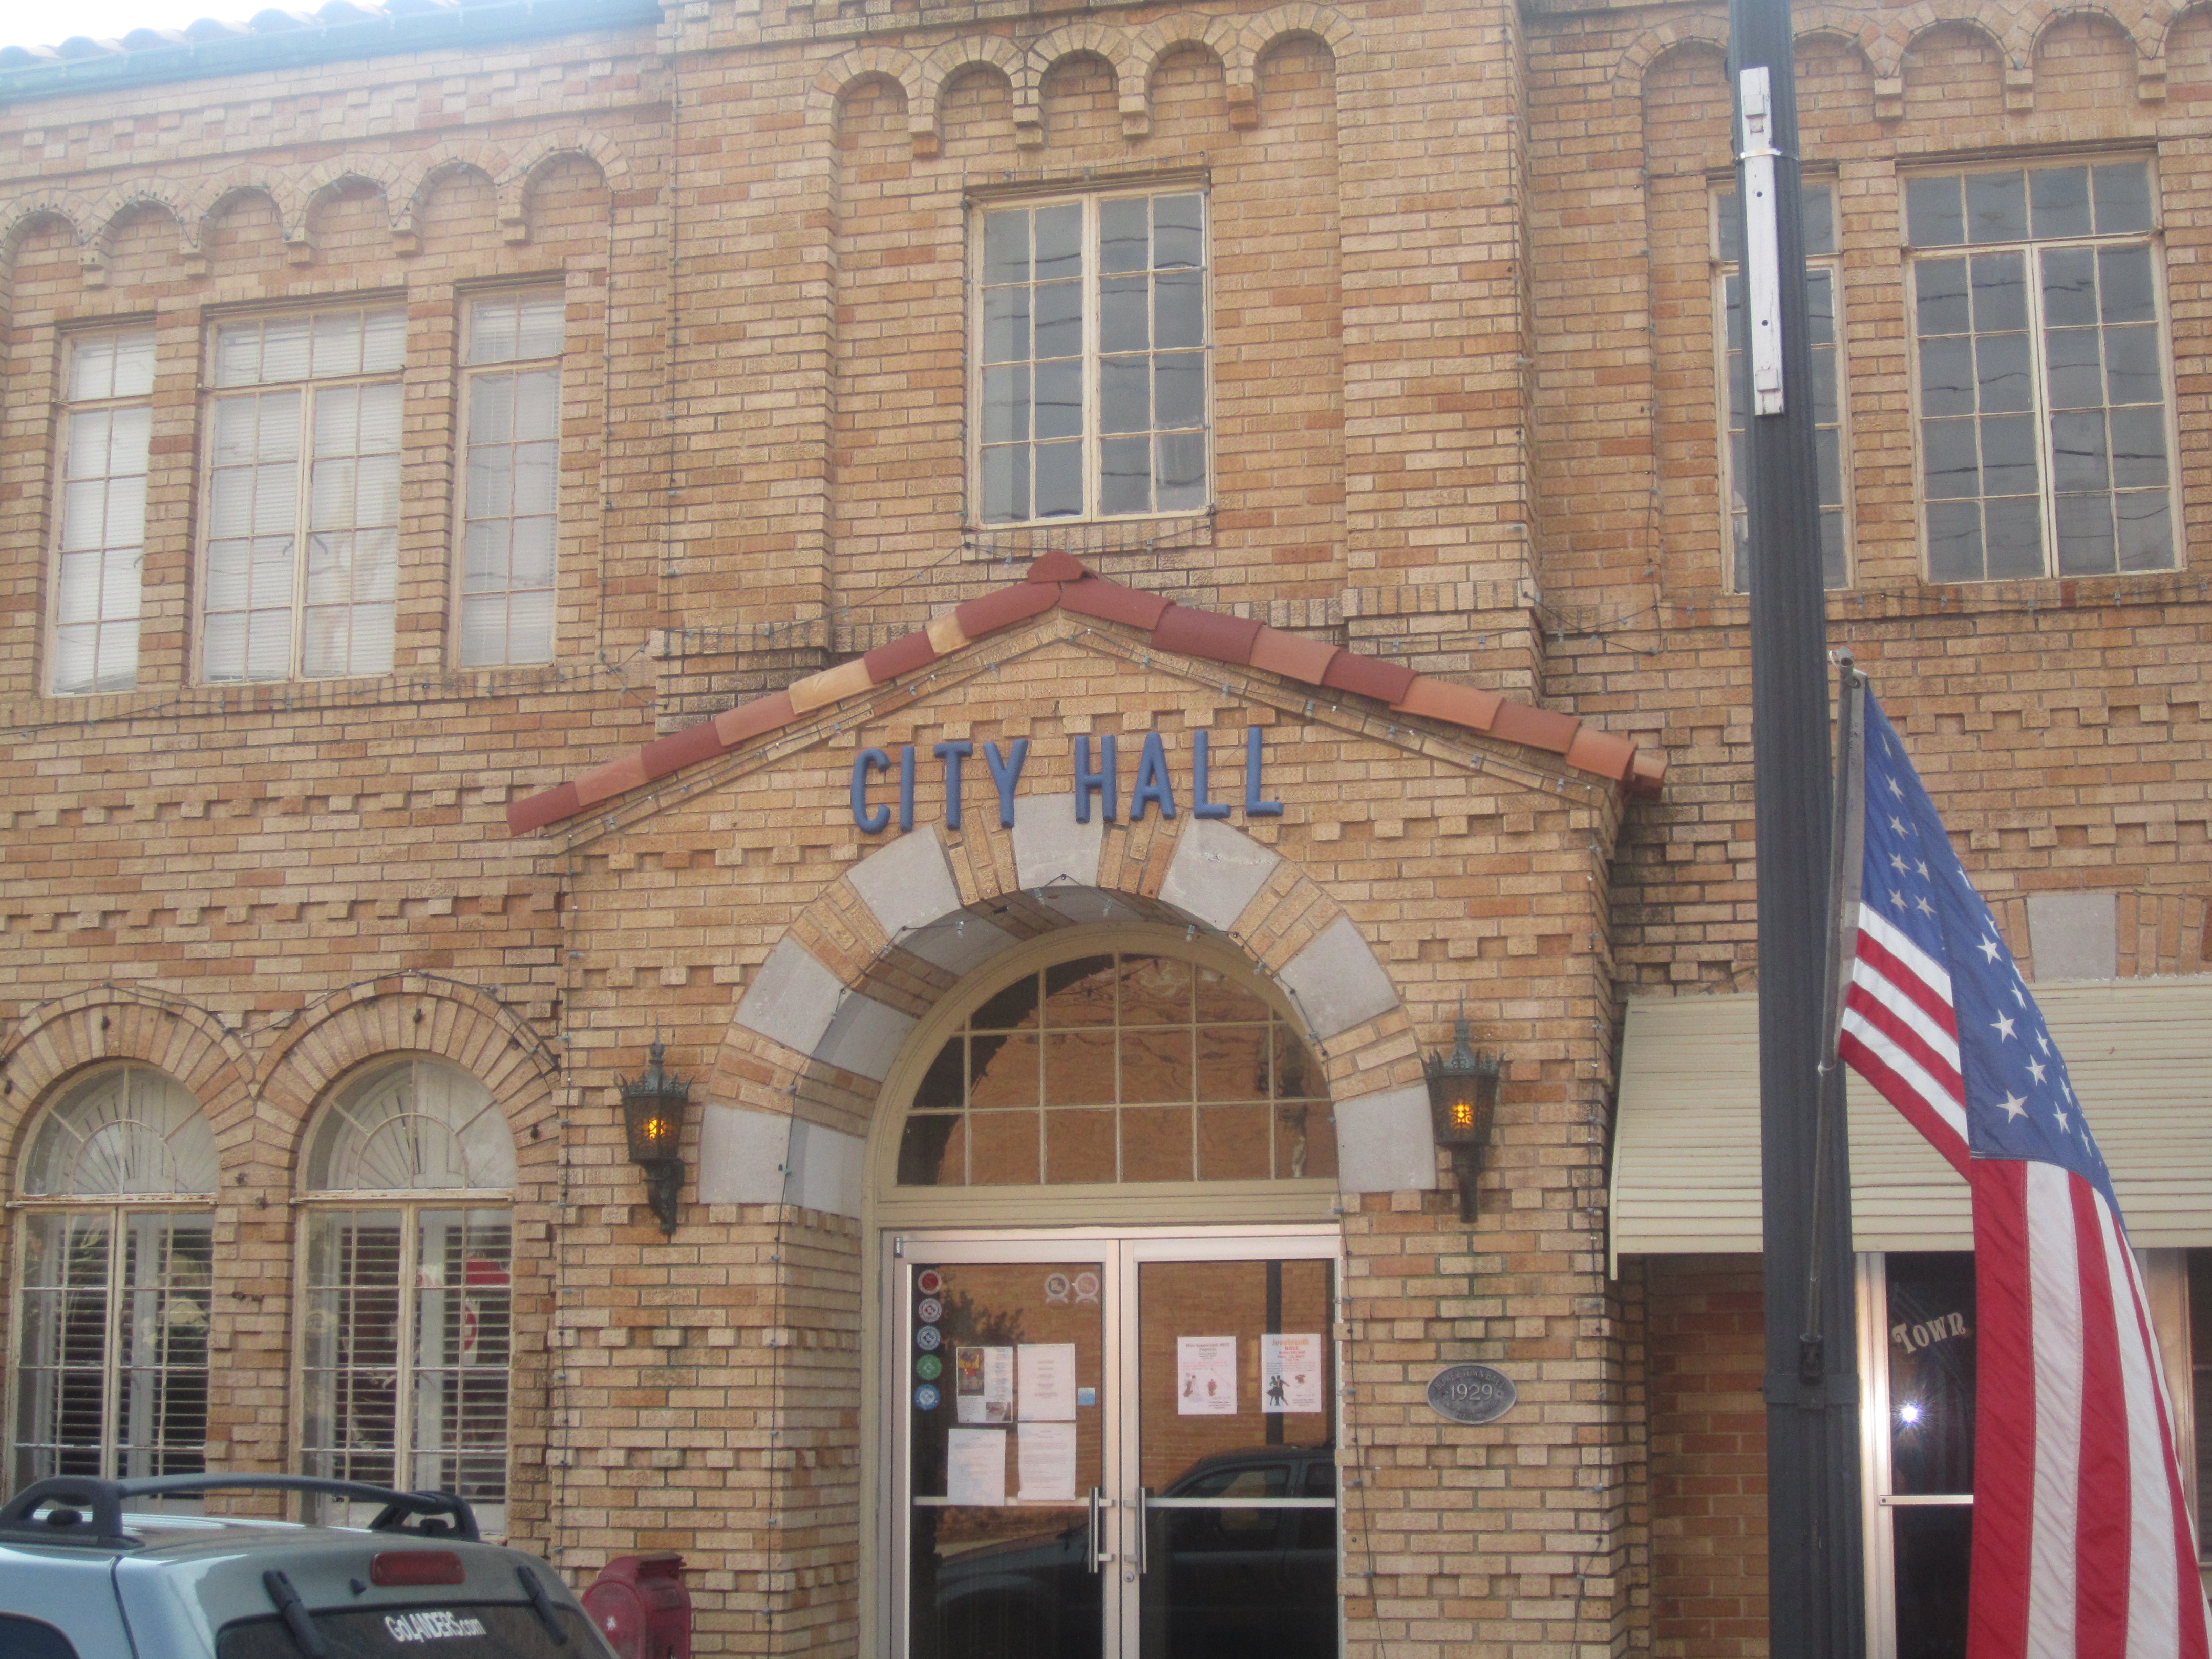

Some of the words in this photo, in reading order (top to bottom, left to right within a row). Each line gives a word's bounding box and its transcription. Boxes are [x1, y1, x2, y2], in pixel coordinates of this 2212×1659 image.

[850, 739, 1029, 835] CITY
[1074, 726, 1283, 823] HALL
[1462, 1368, 1484, 1377] TOWN
[1450, 1384, 1493, 1401] 1929
